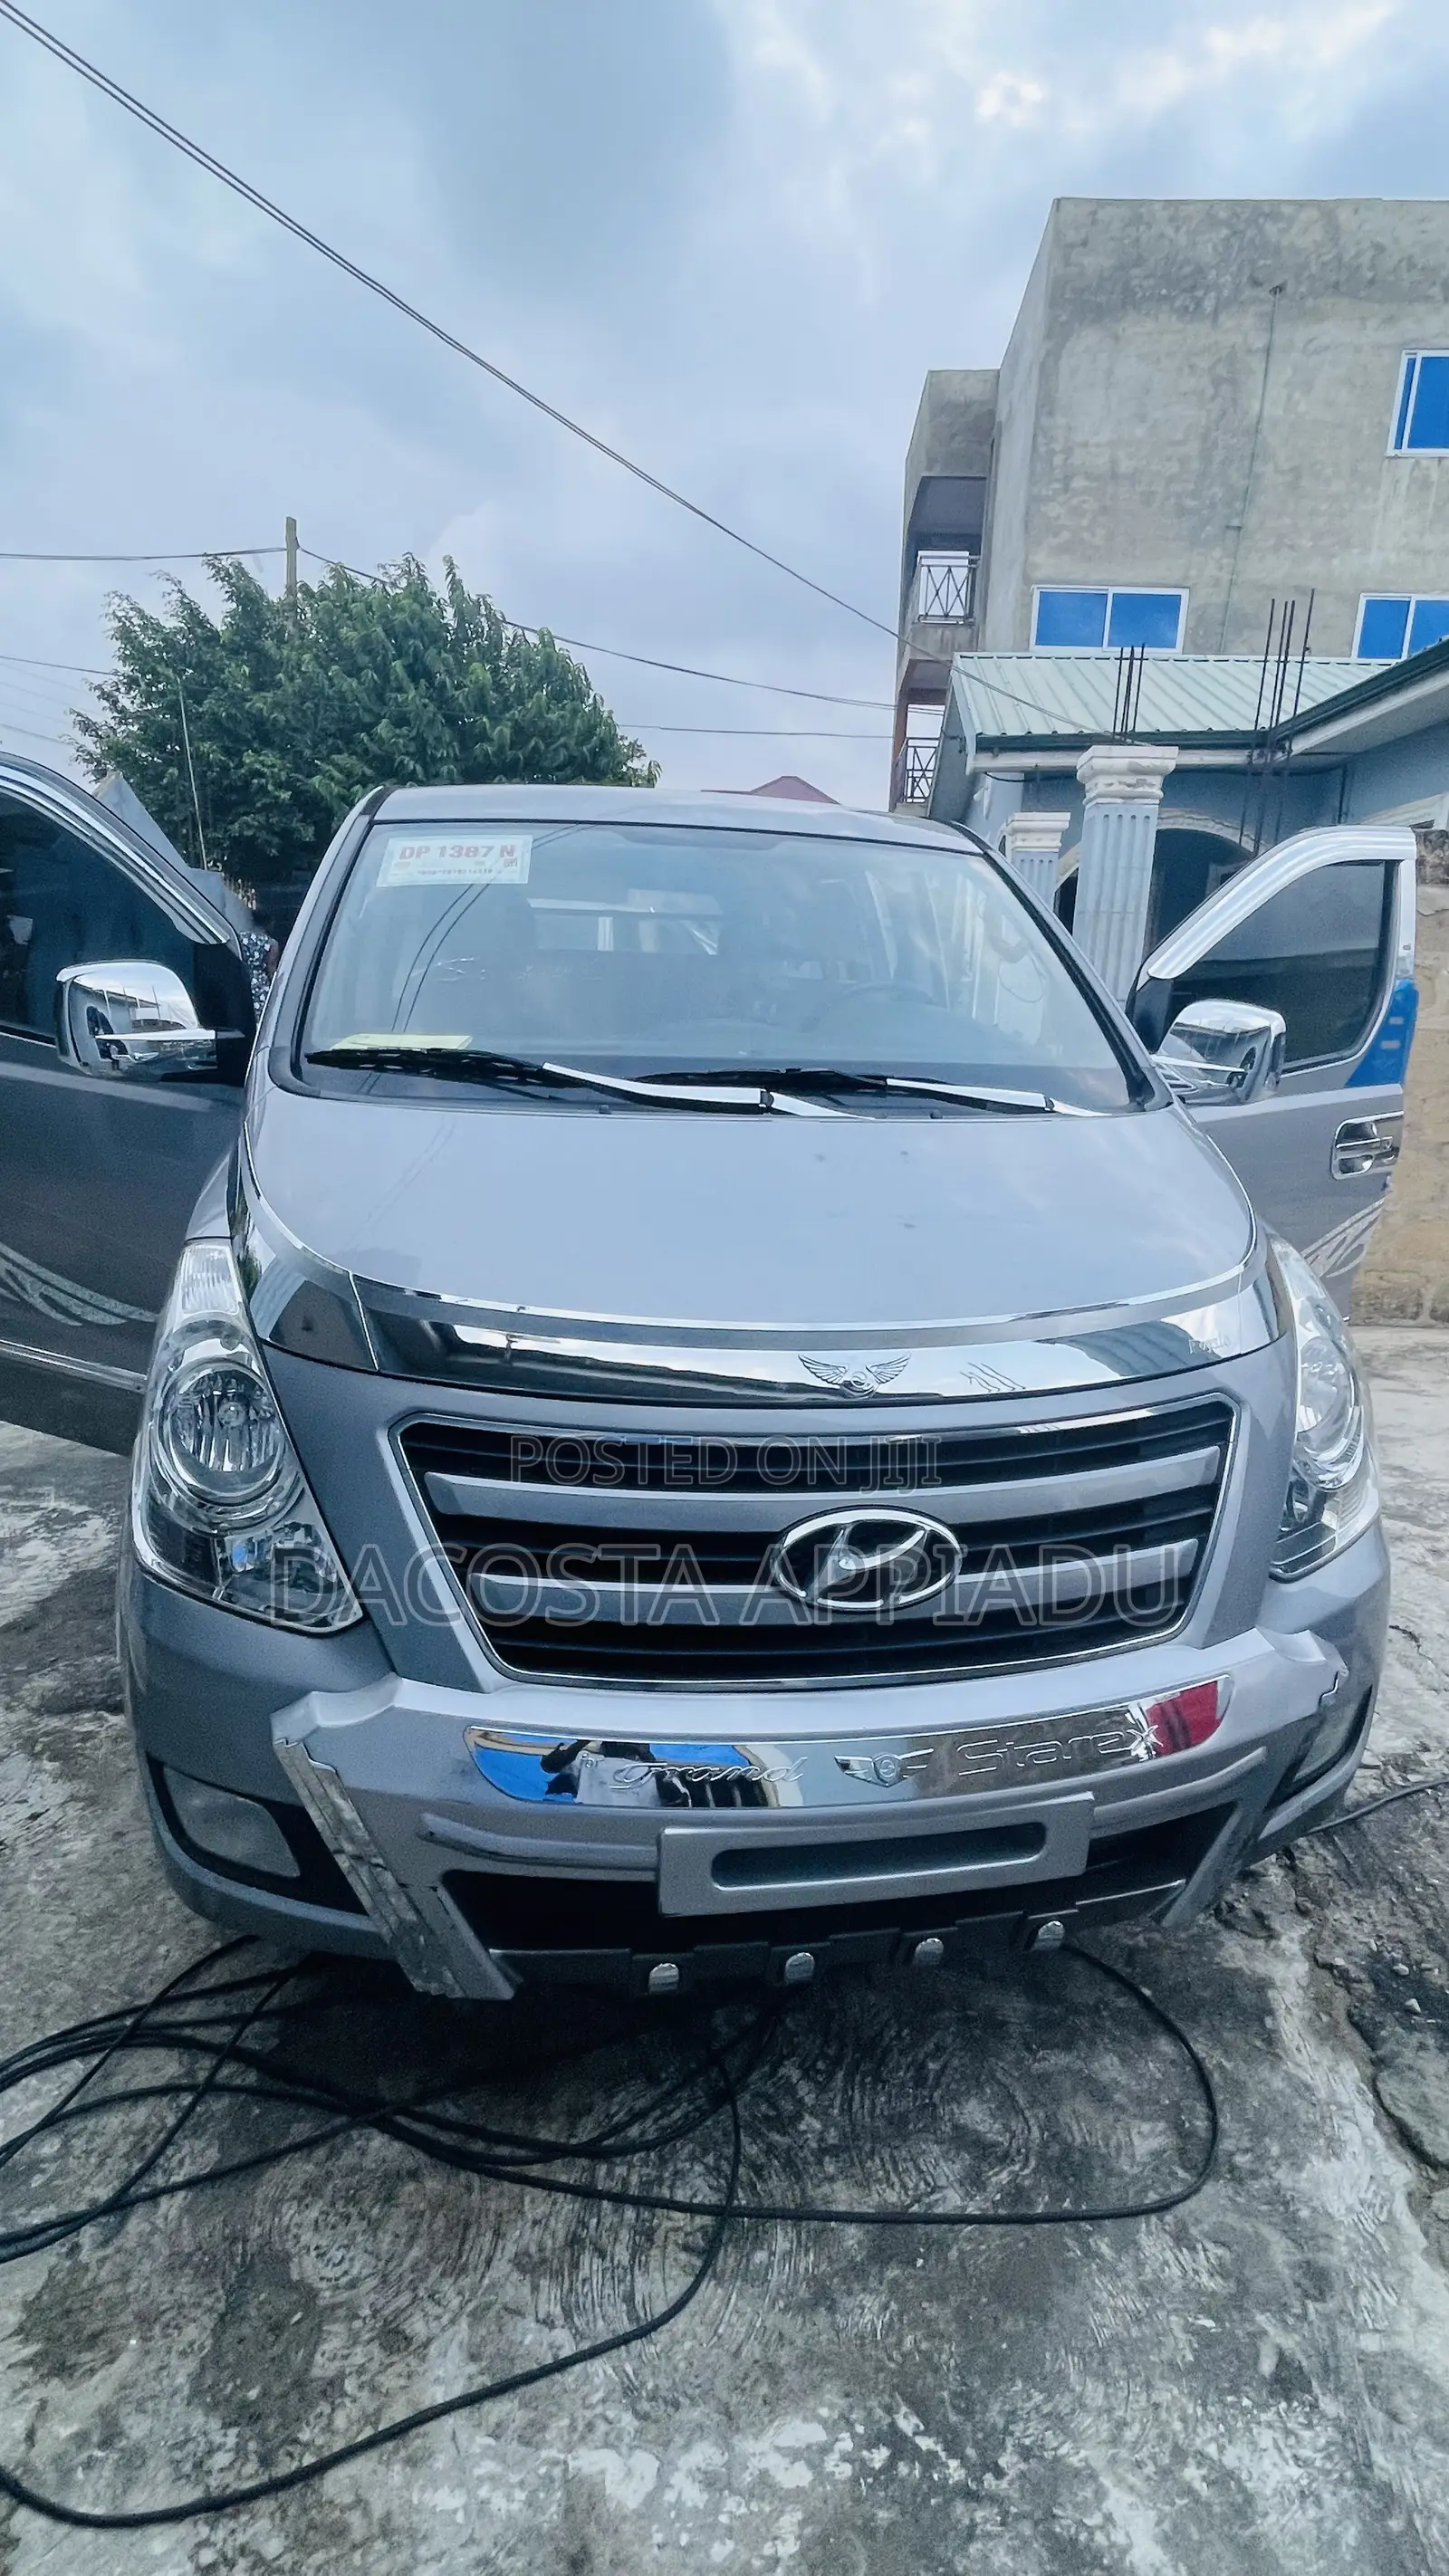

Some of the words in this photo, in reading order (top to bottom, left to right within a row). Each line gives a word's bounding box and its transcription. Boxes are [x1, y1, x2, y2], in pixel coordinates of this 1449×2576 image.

[398, 845, 430, 860] DP
[437, 845, 494, 858] 1387
[499, 844, 515, 858] N
[608, 1757, 809, 1790] Grand
[956, 1724, 1165, 1776] Starex
